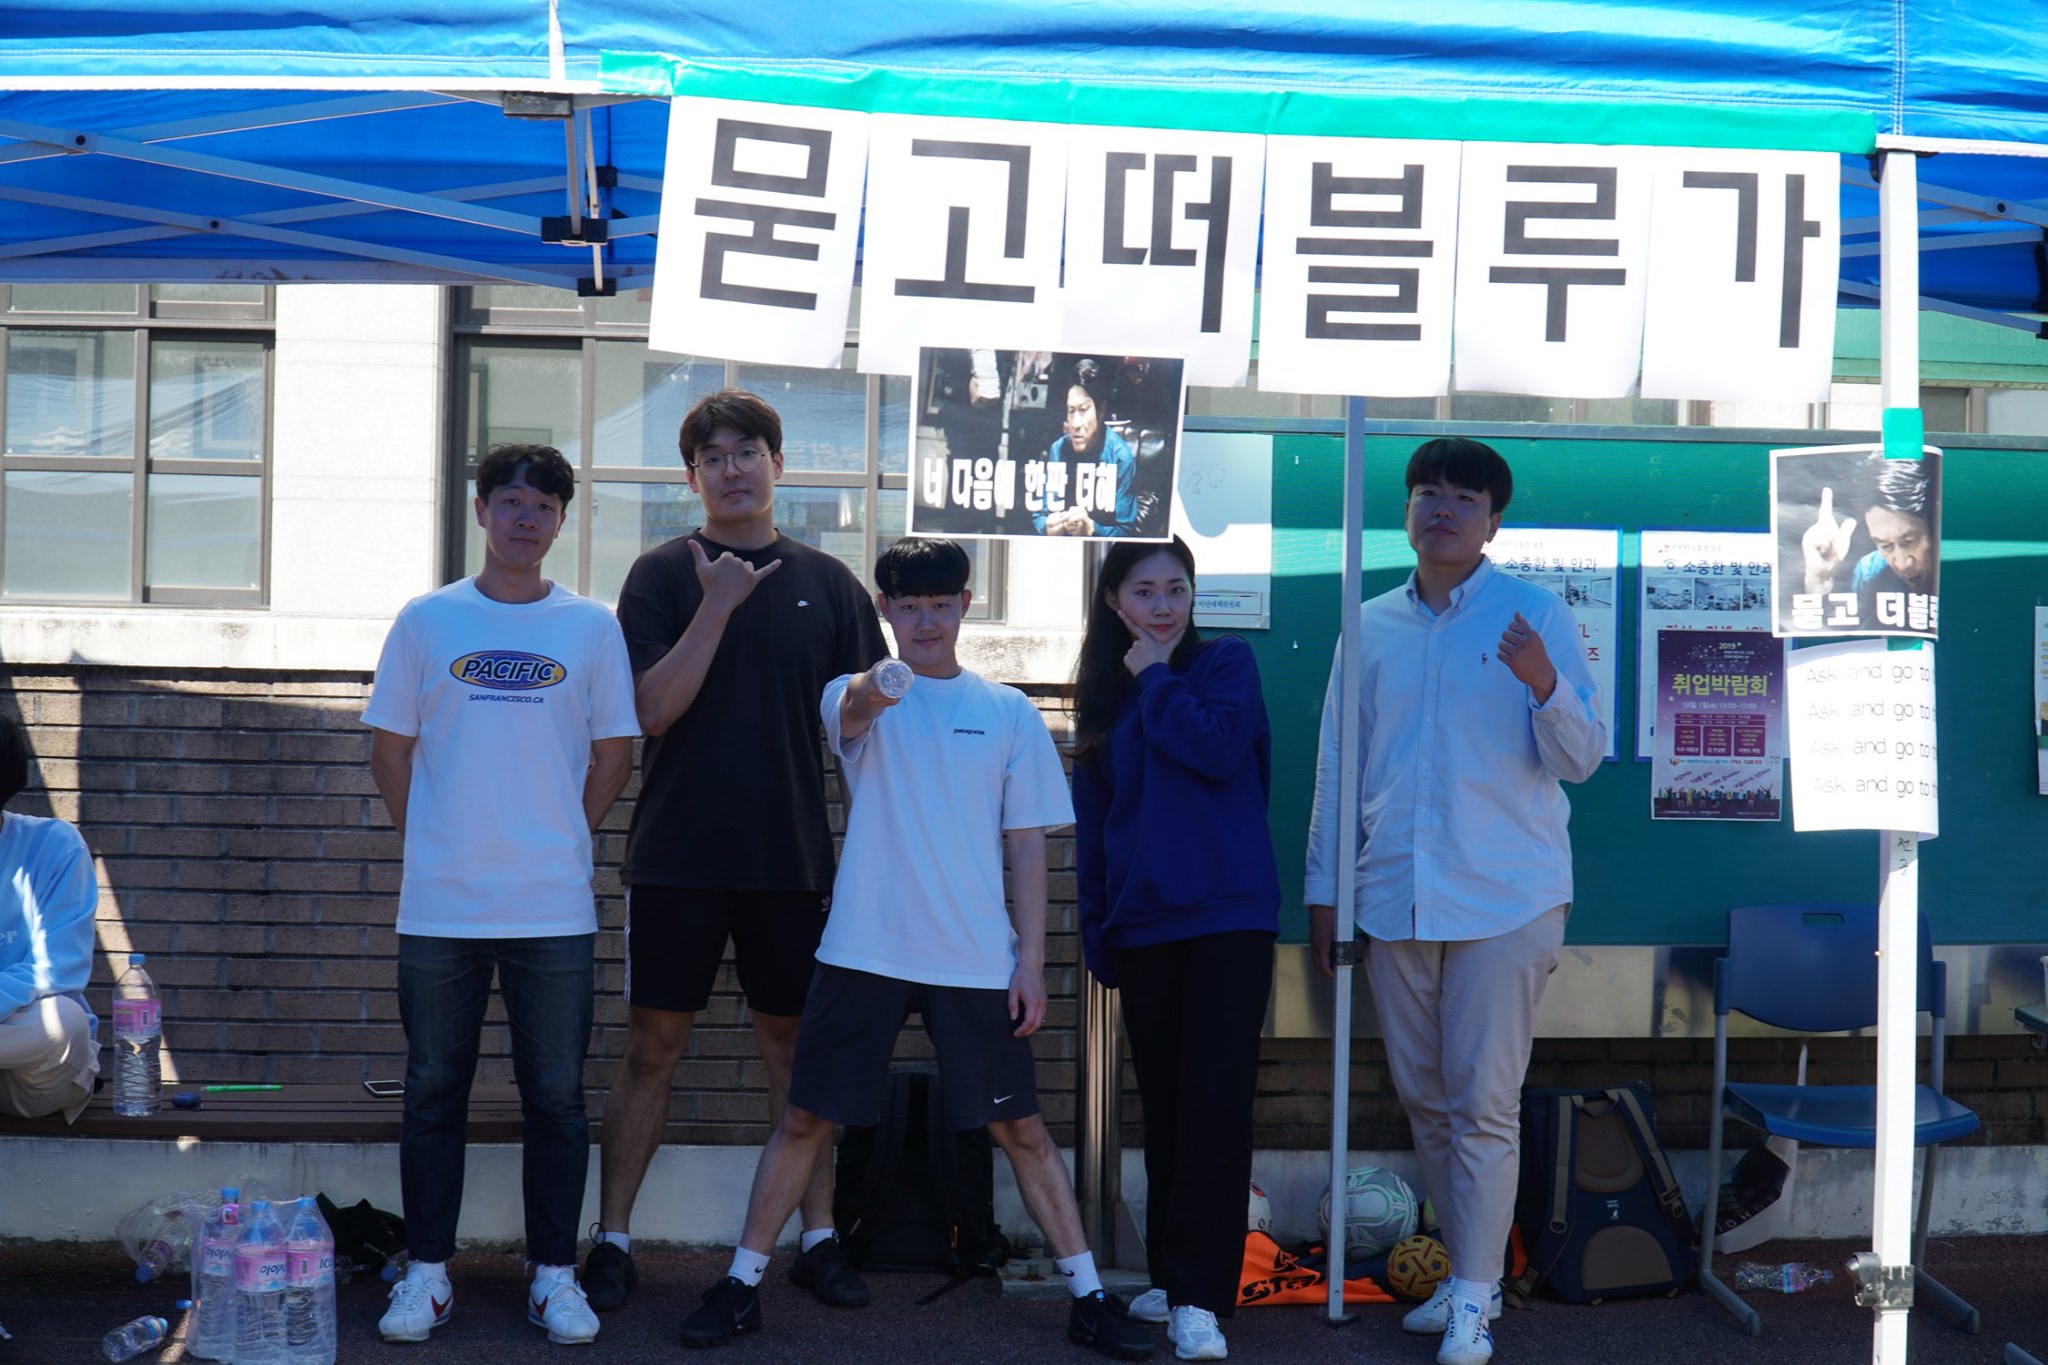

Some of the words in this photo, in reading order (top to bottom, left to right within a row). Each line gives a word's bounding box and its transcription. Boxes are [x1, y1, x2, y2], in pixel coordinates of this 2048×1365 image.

[923, 457, 944, 509] 너
[952, 457, 1015, 511] 다음에
[1024, 459, 1068, 513] 한판
[1075, 462, 1118, 513] 더해
[1505, 556, 1546, 572] 소중한
[1571, 557, 1598, 573] 안과
[1683, 560, 1726, 575] 소중한
[1719, 642, 1736, 650] 2019
[461, 659, 557, 682] PACIFIC
[1805, 665, 1840, 684] Ask
[1848, 662, 1882, 680] and
[1892, 665, 1913, 684] go
[1920, 665, 1931, 682] to
[1672, 673, 1767, 696] 취업박람회
[468, 694, 544, 704] SANFRANCISCO.CA
[1807, 702, 1841, 720] Ask
[1850, 699, 1884, 717] and
[1894, 703, 1914, 722] go
[1920, 702, 1931, 720] to
[1810, 738, 1844, 757] Ask
[1853, 736, 1886, 755] and
[1895, 740, 1915, 760] go
[1920, 740, 1931, 759] to
[1812, 775, 1847, 794] Ask
[1856, 773, 1888, 793] and
[1896, 779, 1915, 799] go
[1919, 778, 1930, 797] to
